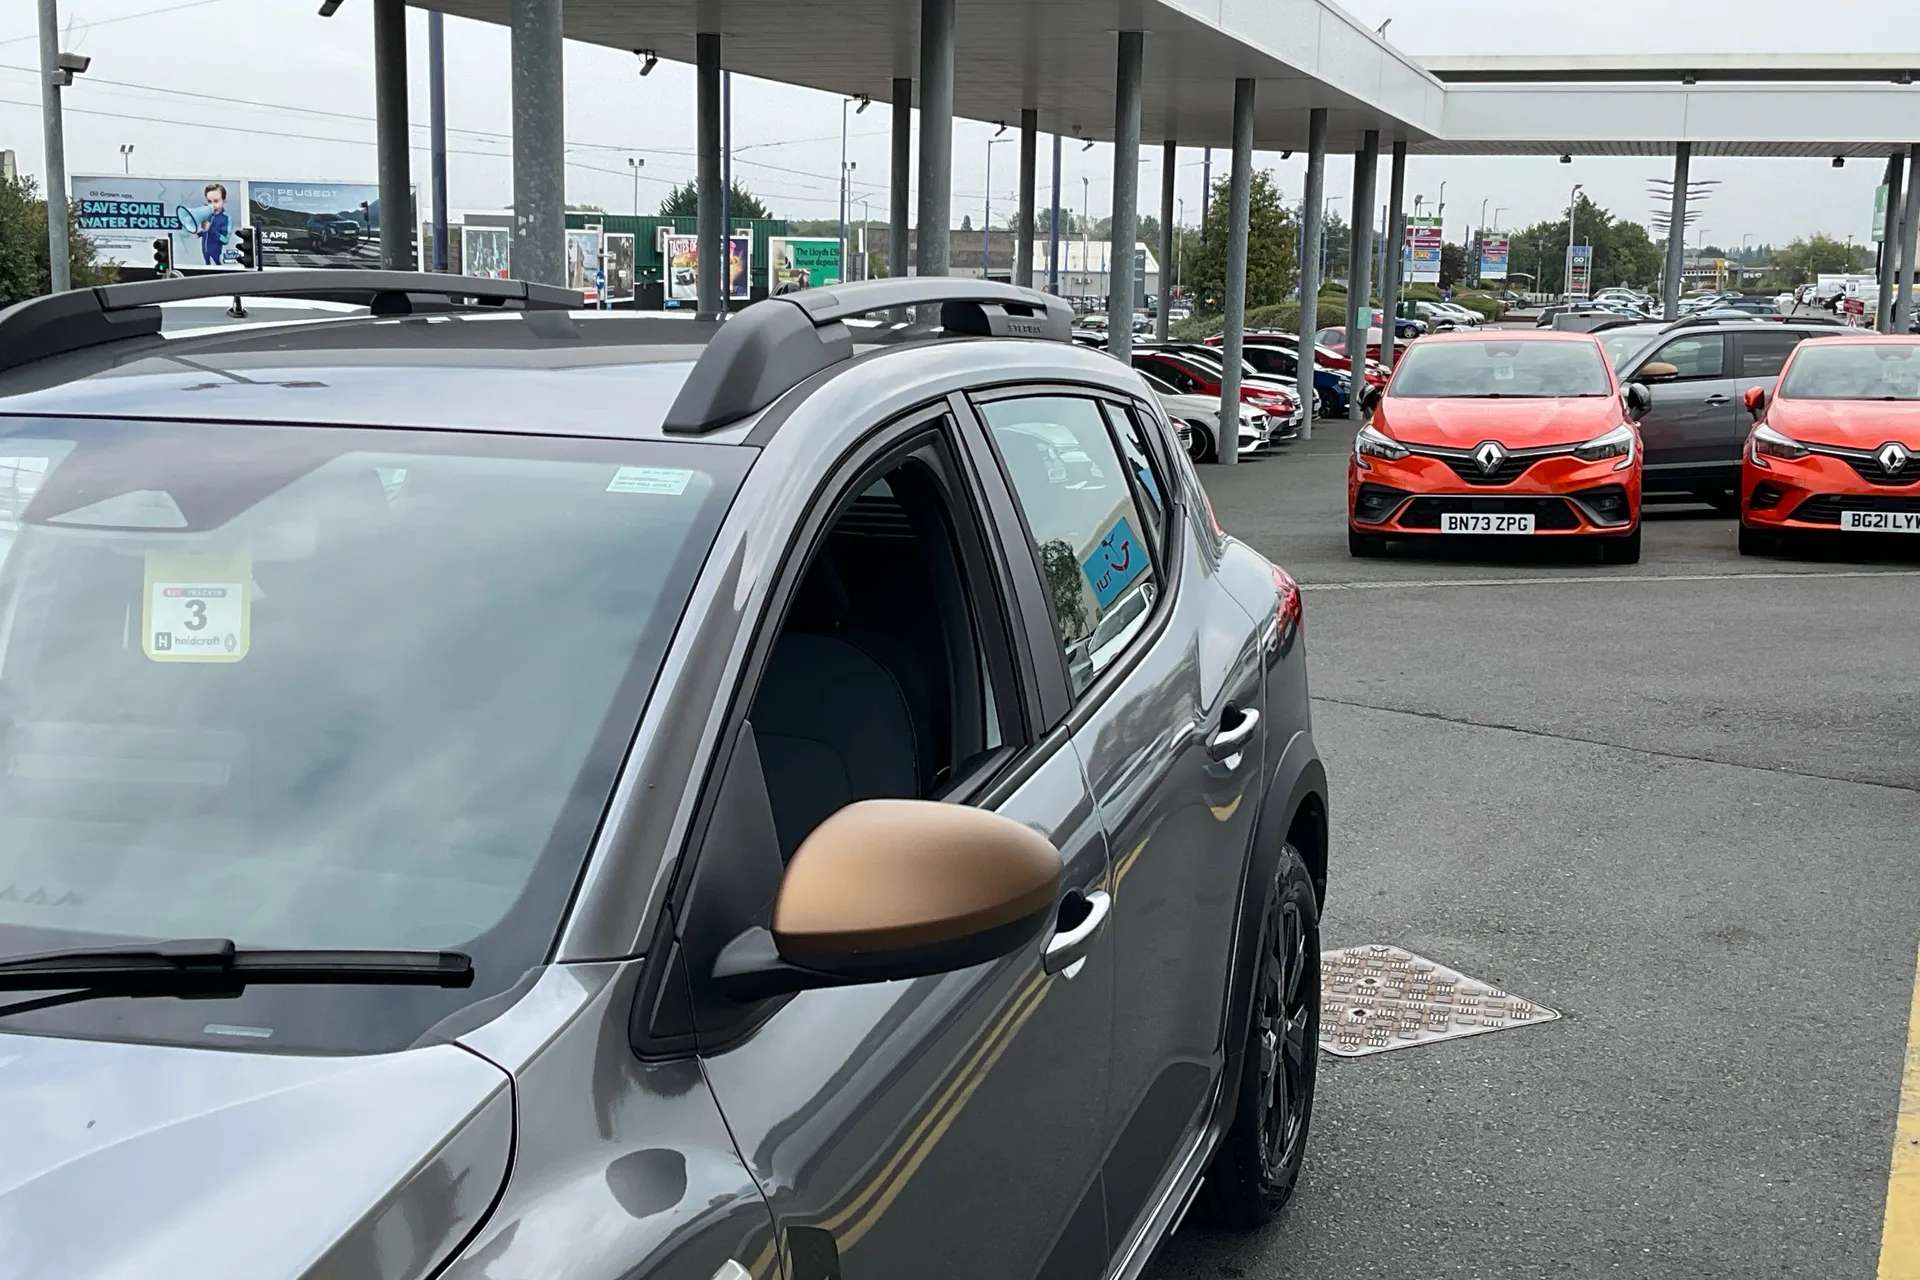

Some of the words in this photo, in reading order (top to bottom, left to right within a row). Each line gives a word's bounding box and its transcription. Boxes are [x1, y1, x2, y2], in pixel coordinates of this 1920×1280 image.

[277, 188, 337, 198] PEUGEOT
[83, 202, 118, 214] SAVE
[119, 203, 161, 216] SOME
[79, 216, 128, 228] WATER
[129, 217, 159, 228] FOR
[160, 217, 178, 228] US
[269, 231, 288, 239] APR
[669, 239, 690, 258] TASTES
[796, 247, 808, 256] The
[809, 247, 828, 259] Lloyds
[796, 258, 815, 266] house
[1448, 516, 1491, 531] BN73
[1495, 516, 1528, 531] ZPG
[1851, 513, 1888, 528] BG21
[184, 599, 208, 631] 3
[157, 633, 169, 649] H
